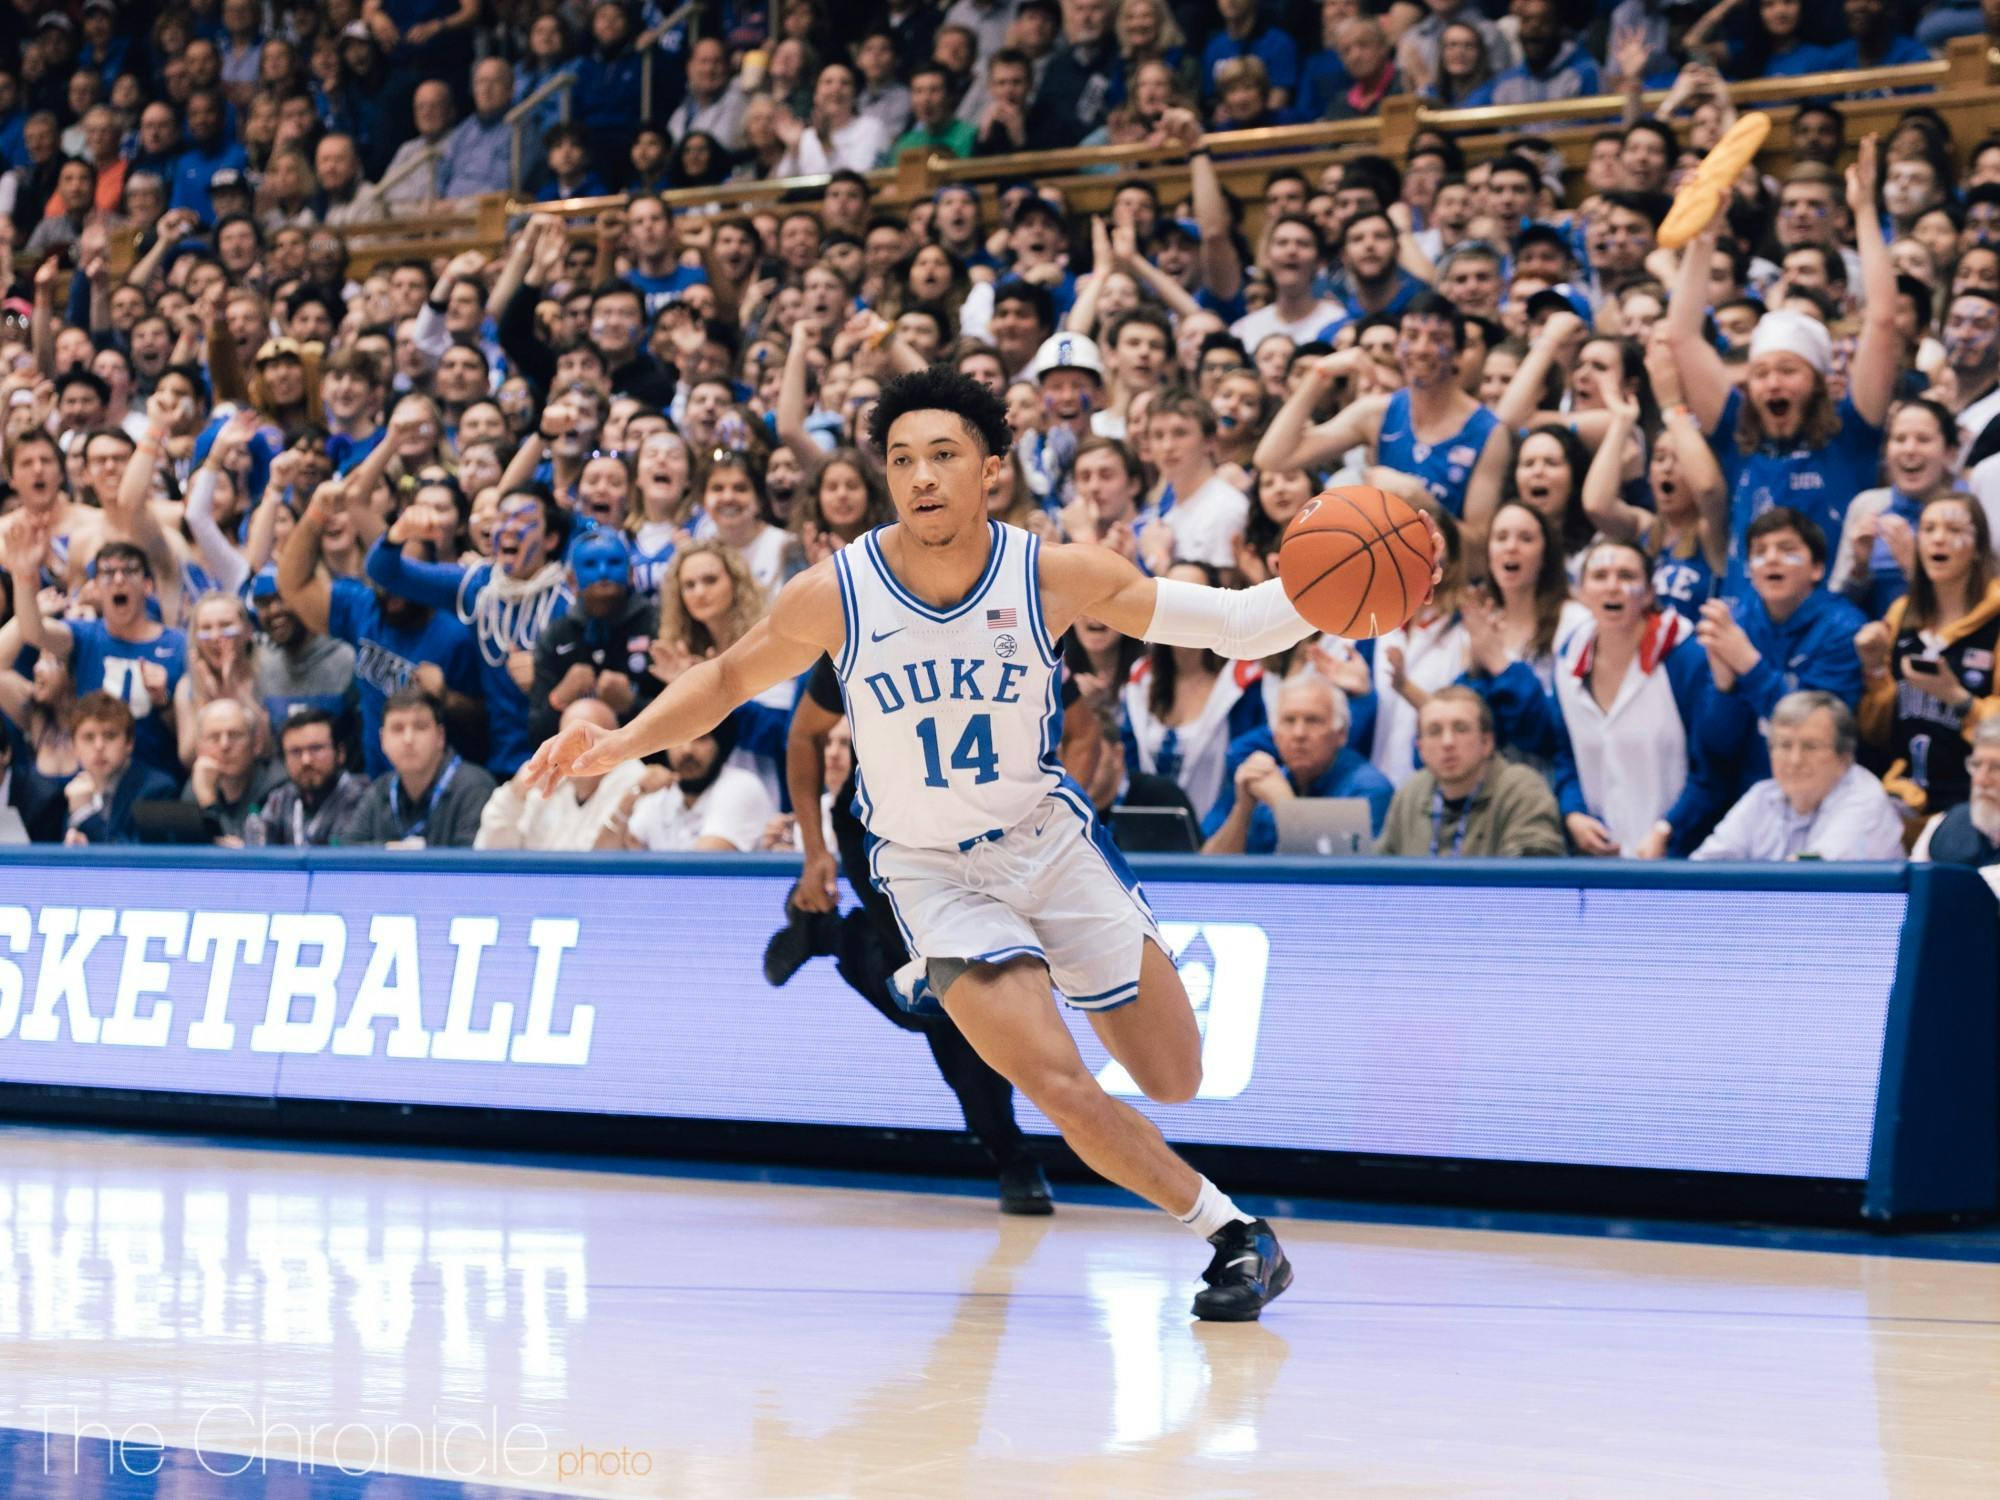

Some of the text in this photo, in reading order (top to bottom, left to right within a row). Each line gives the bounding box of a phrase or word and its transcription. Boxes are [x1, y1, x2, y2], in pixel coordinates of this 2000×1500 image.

[355, 636, 419, 698] DUK
[864, 658, 1028, 714] DUKE
[915, 713, 999, 788] 14
